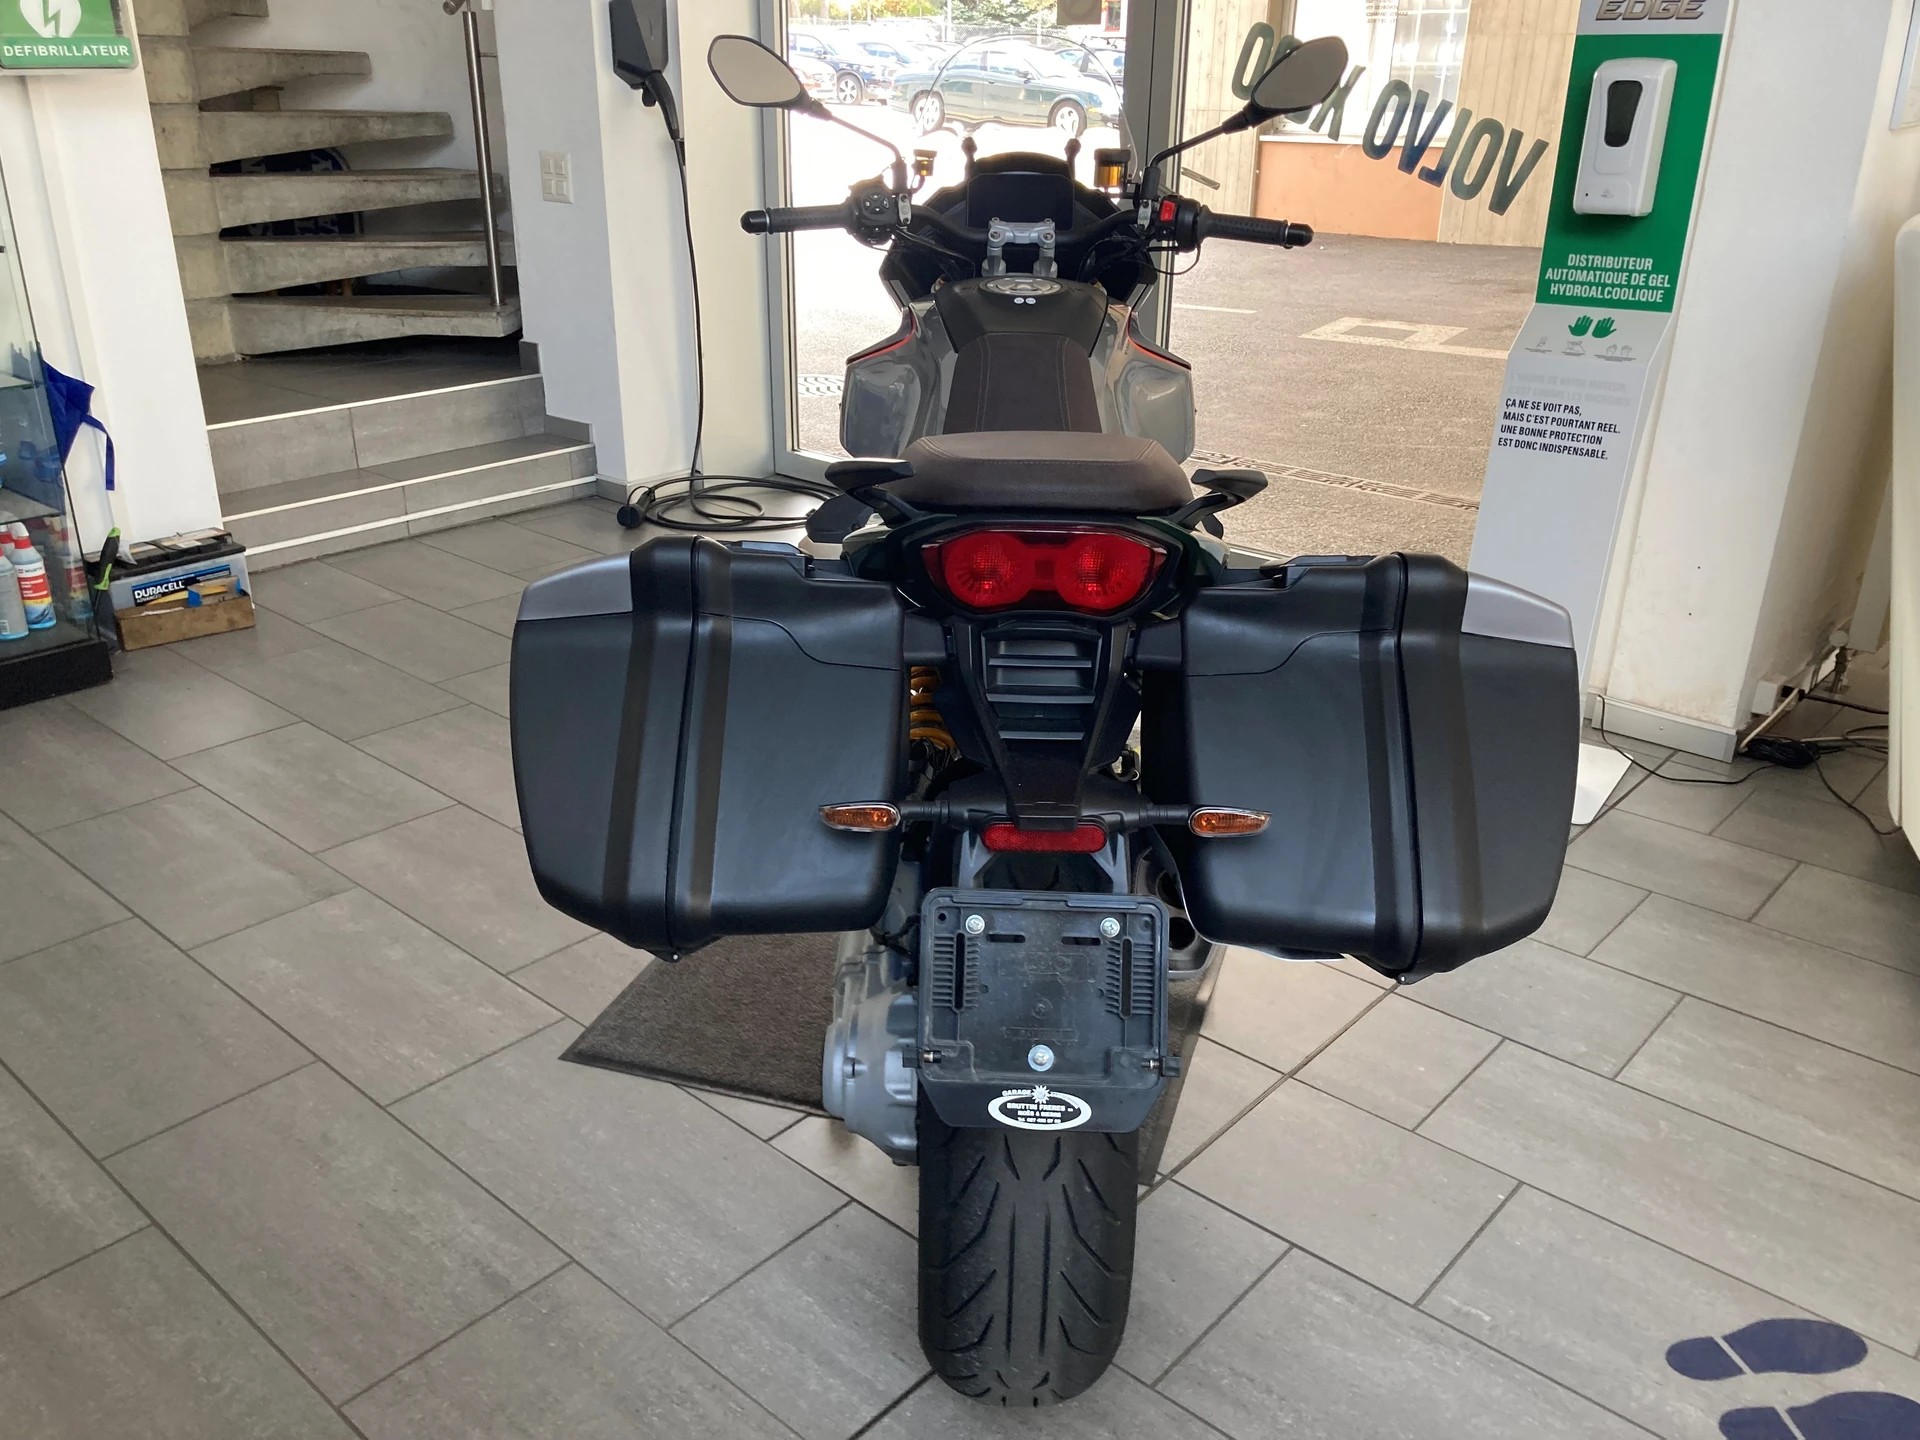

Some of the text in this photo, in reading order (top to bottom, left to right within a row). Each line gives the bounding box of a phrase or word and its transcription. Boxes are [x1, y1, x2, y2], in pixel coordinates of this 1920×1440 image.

[1595, 0, 1705, 20] EDGE
[3, 45, 130, 57] DEFIBRILLATEUR
[1567, 253, 1653, 271] DISTRIBUTEUR
[1545, 268, 1671, 288] AUTOMATIQUE DE GEL
[1550, 283, 1664, 302] HYDROALCOOLIQUE
[1505, 398, 1582, 417] ÇA NE SE VOIT PAS,
[1503, 411, 1621, 434] MAIS C'EST POURTANT REEL.
[1500, 424, 1603, 446] UNE BONNE PROTECTION
[1498, 437, 1608, 460] EST DONC INDISPENSABLE.
[134, 580, 185, 599] DURACELL
[1001, 1089, 1031, 1097] GARAGE
